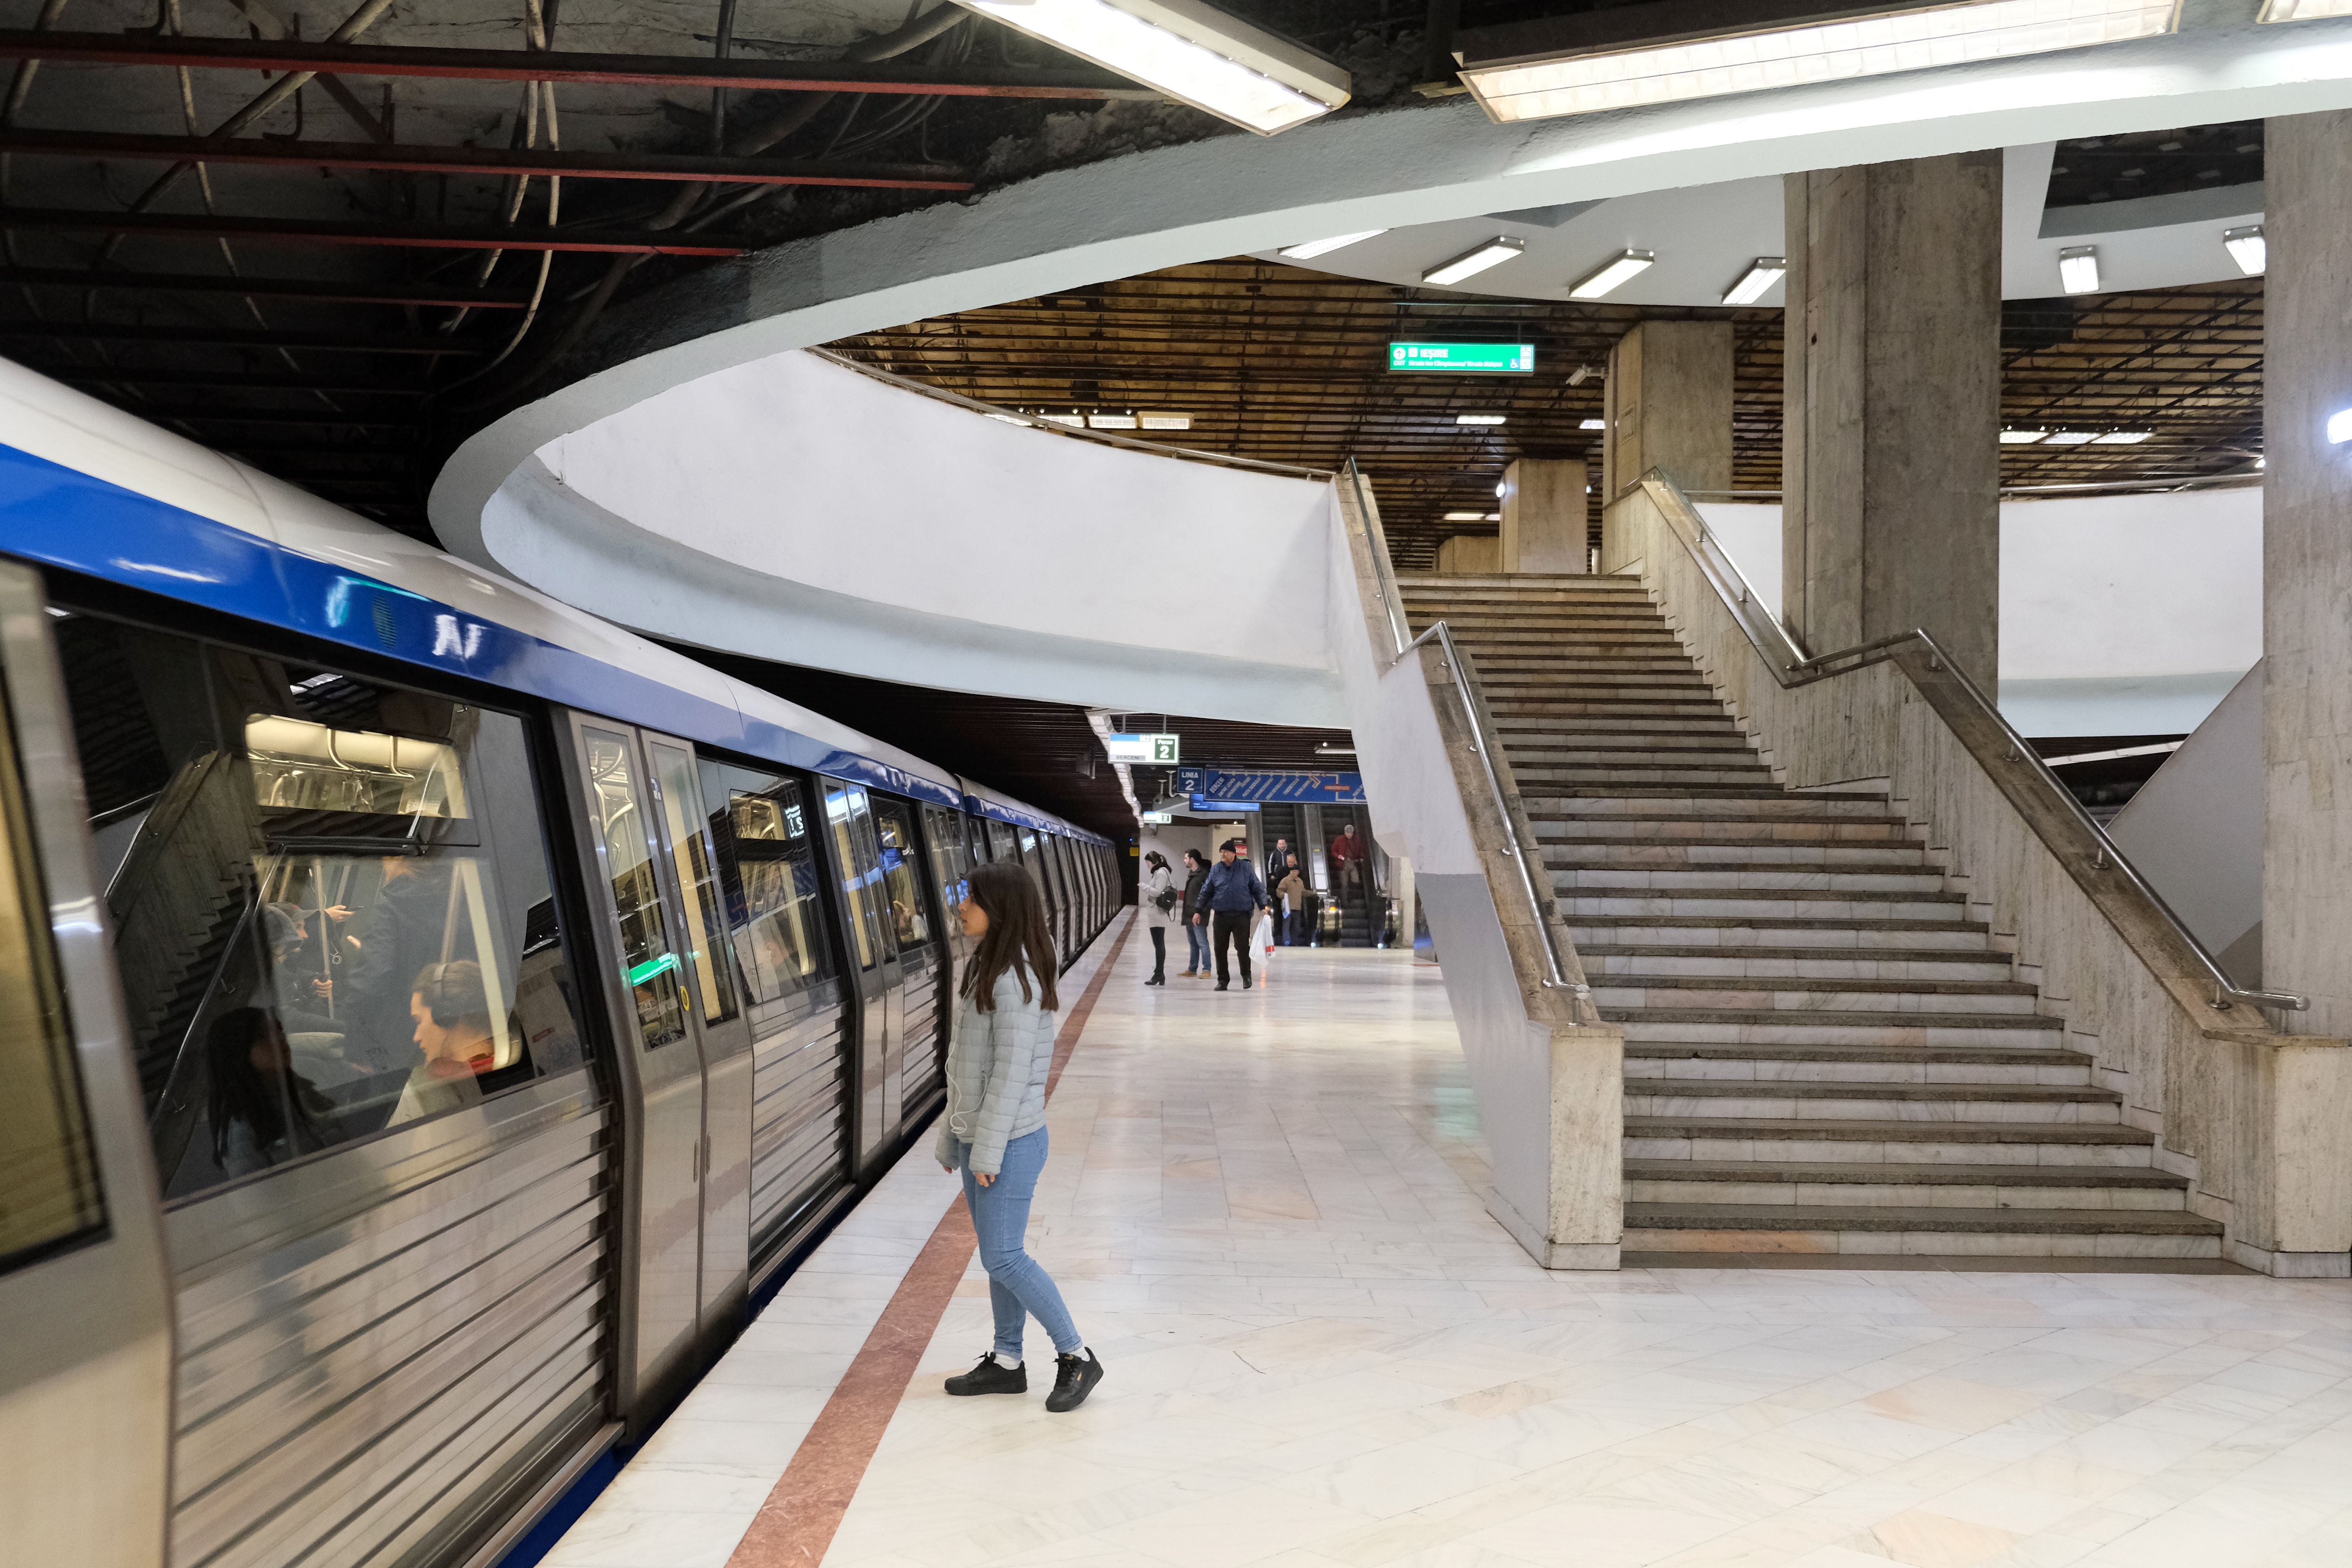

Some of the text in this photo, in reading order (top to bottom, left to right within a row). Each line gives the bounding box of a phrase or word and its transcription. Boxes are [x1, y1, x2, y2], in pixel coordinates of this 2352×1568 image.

[1420, 348, 1448, 360] IEȘIRE
[1160, 745, 1169, 758] 2
[1185, 780, 1194, 791] 2
[1209, 777, 1225, 793] BERCENI
